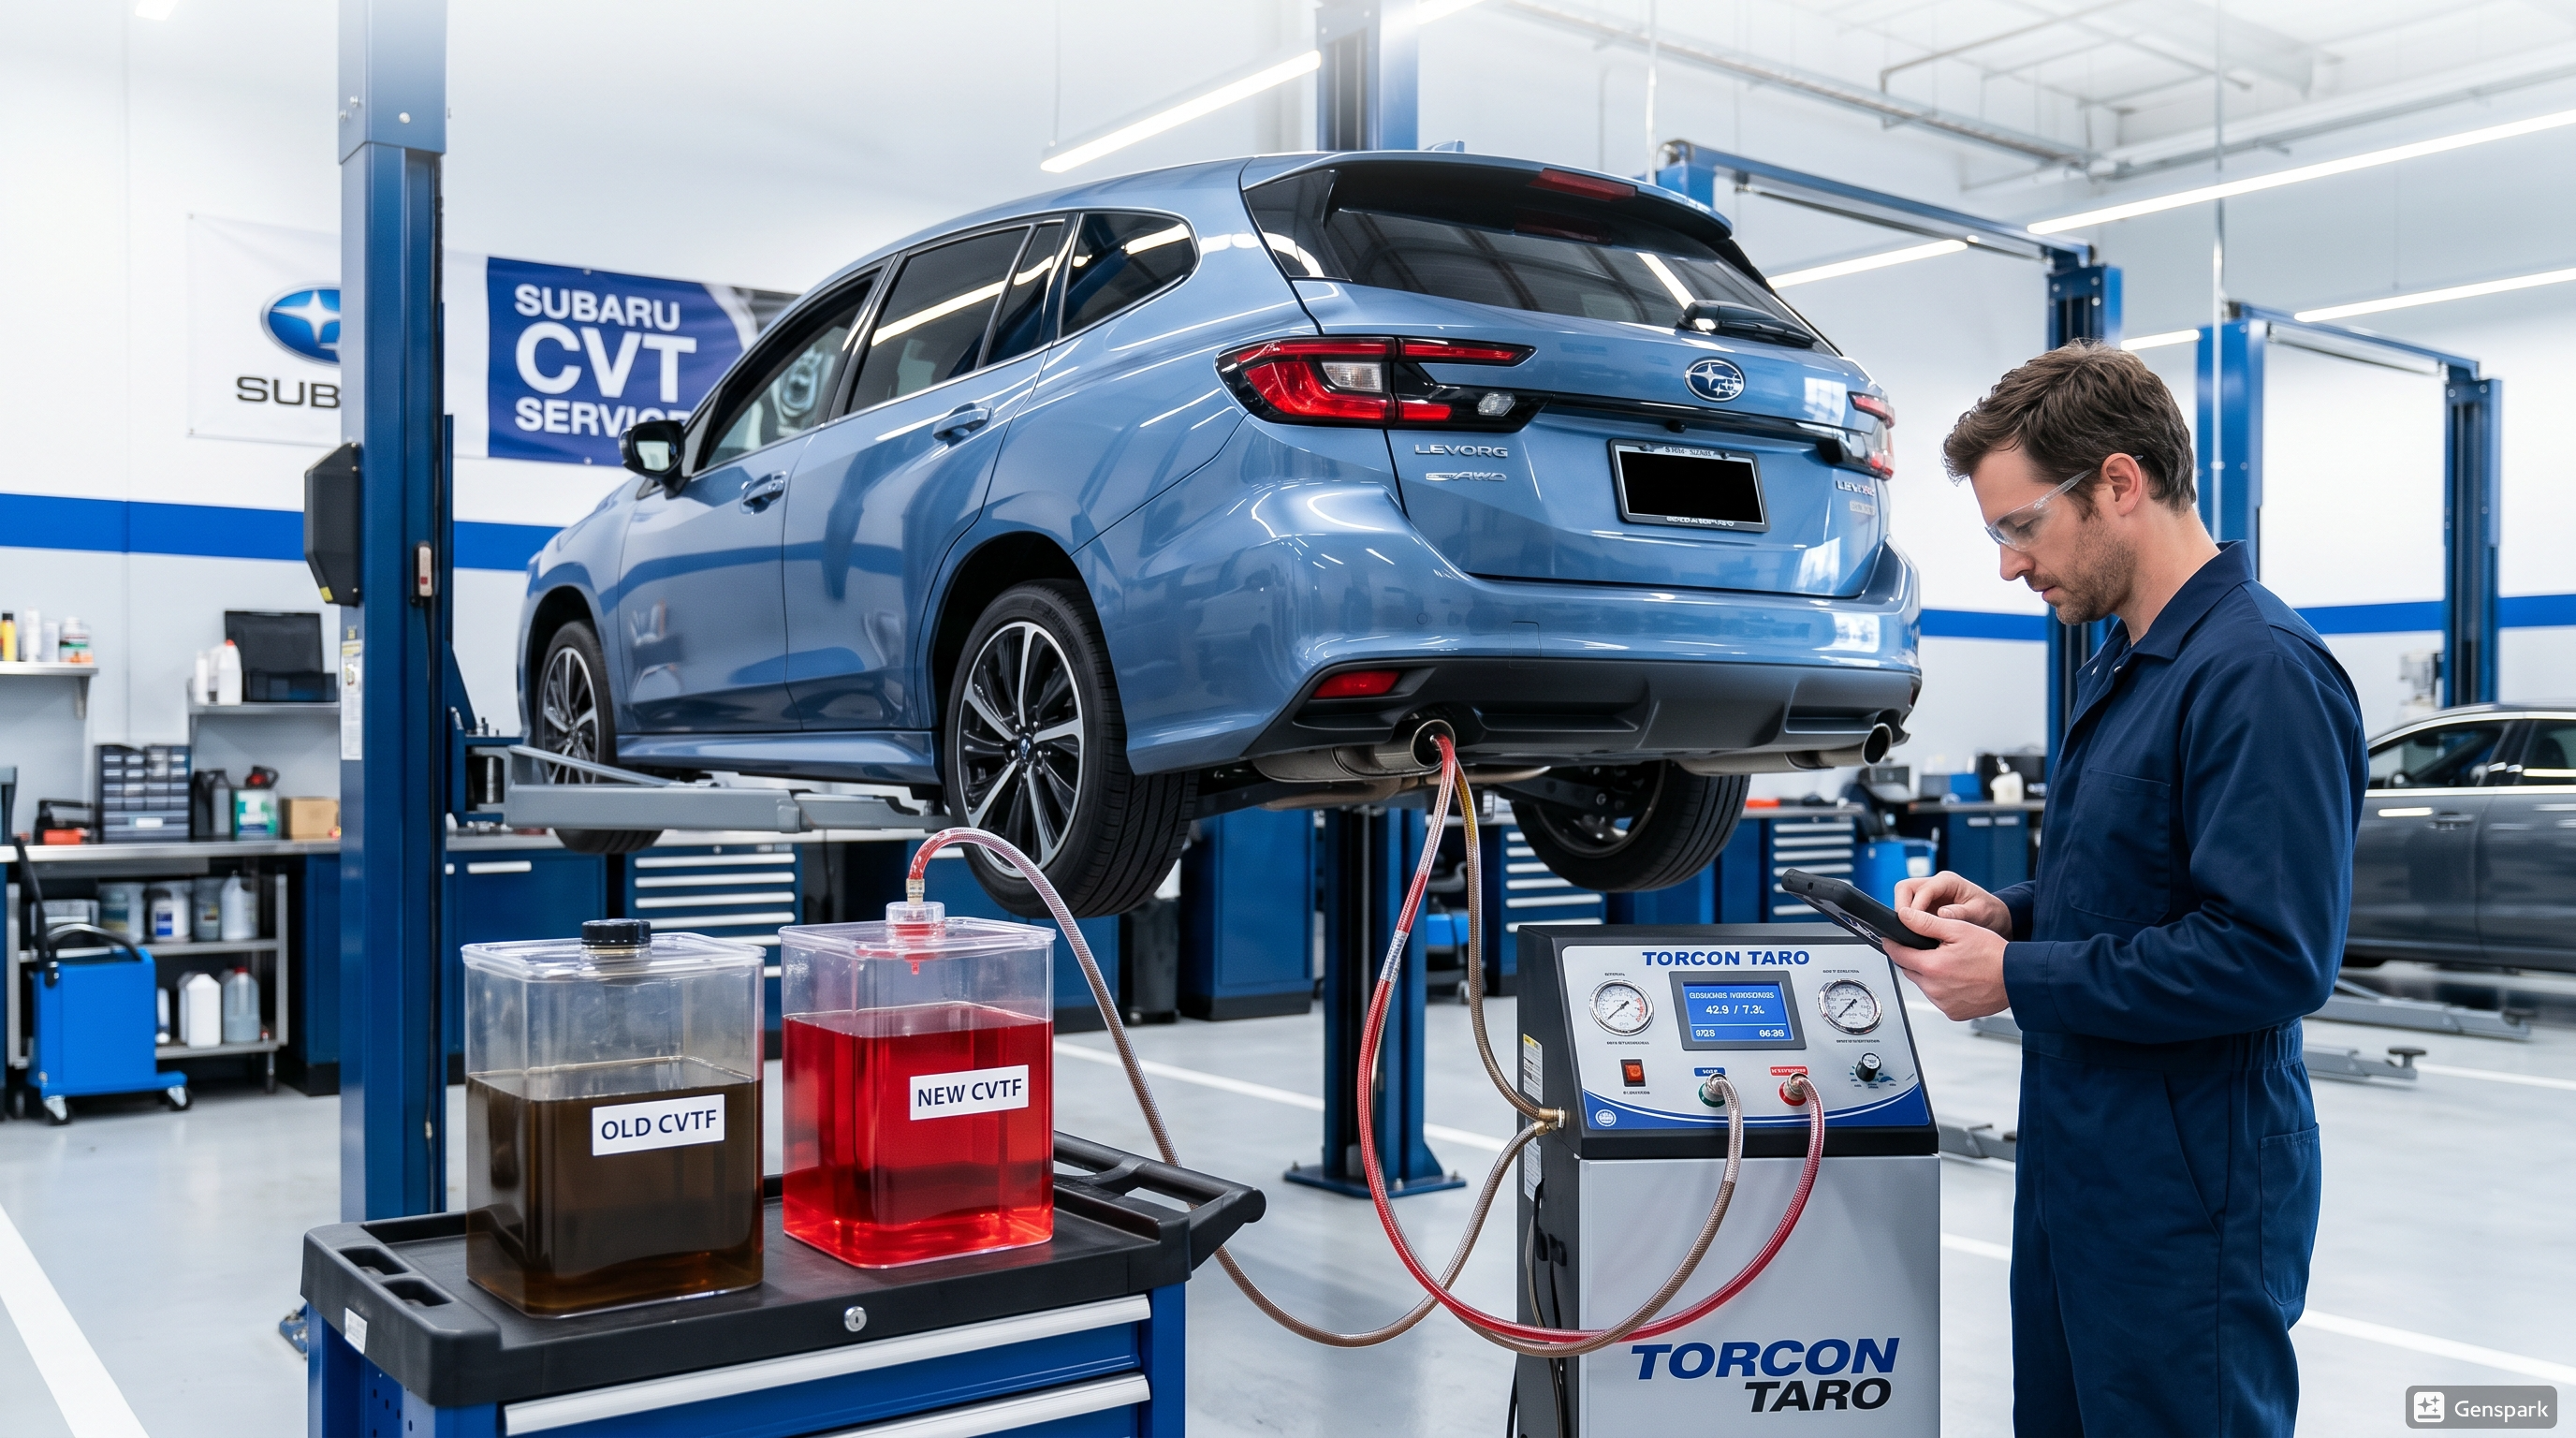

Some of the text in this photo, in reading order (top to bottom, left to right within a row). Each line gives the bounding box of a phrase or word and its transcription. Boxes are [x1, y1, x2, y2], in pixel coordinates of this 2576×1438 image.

[515, 283, 681, 332] SUBARU
[515, 320, 696, 404] CVT
[1414, 444, 1509, 458] LEVORG
[1642, 950, 1810, 966] TORCON TARO
[1705, 1005, 1729, 1015] 42.9
[917, 1078, 1022, 1108] NEW CVTF
[601, 1109, 717, 1140] OLD CVTF
[1631, 1337, 1900, 1380] TORCON
[1744, 1377, 1893, 1413] TARO
